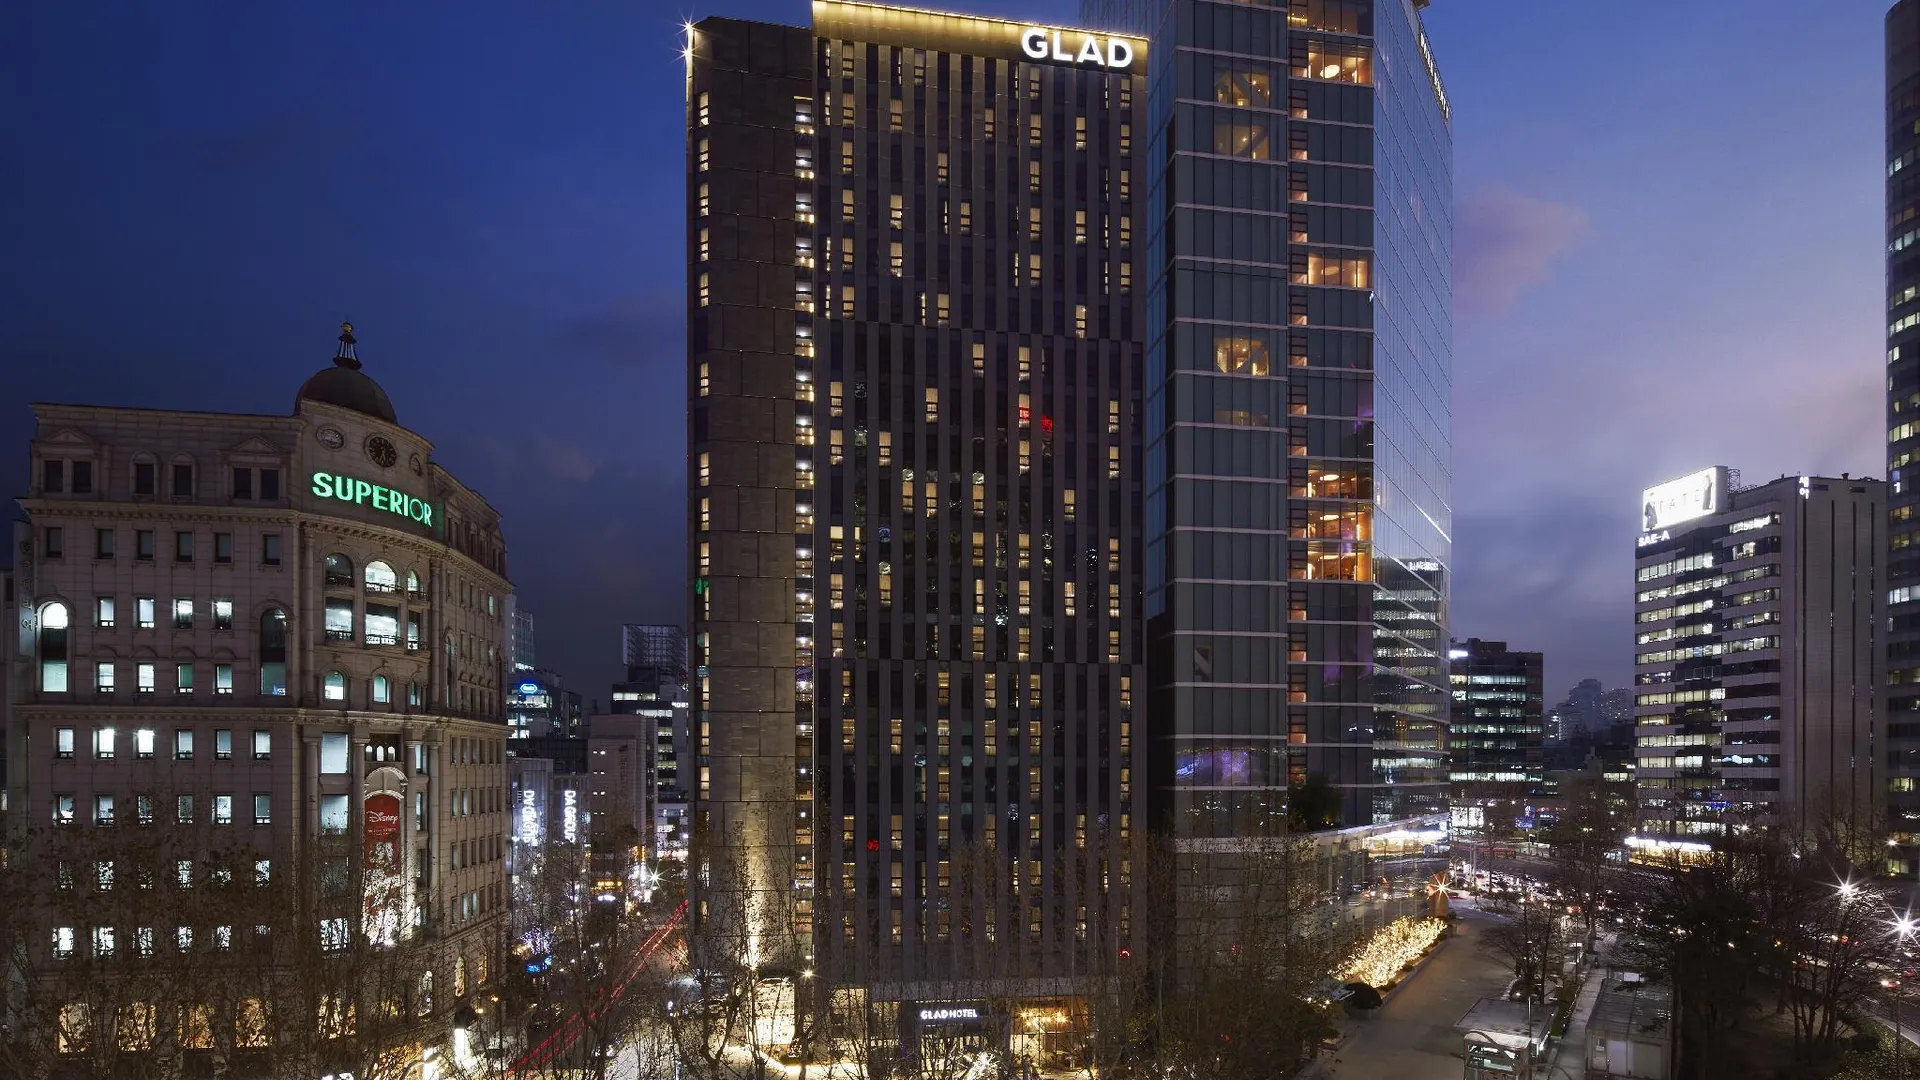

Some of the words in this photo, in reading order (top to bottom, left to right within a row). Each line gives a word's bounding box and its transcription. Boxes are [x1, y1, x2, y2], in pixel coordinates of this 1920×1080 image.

[1021, 27, 1133, 68] GLAD
[312, 472, 432, 528] SUPERIOR
[1638, 530, 1670, 547] SAE-A
[564, 790, 577, 806] DA
[365, 810, 399, 825] Disney
[564, 806, 577, 844] GROUP
[920, 1009, 949, 1020] GLAD
[949, 1008, 978, 1018] HOTEL
